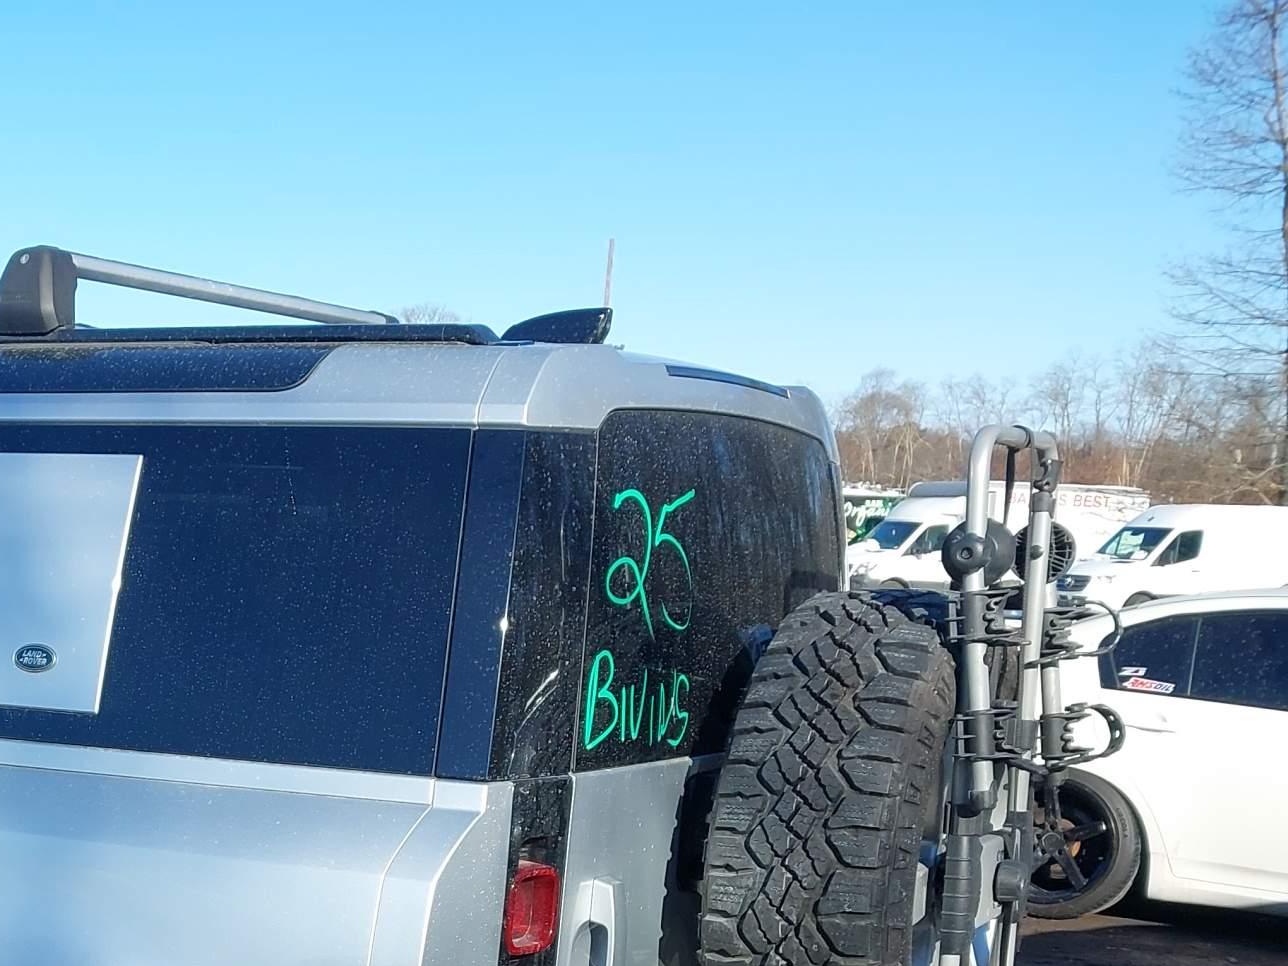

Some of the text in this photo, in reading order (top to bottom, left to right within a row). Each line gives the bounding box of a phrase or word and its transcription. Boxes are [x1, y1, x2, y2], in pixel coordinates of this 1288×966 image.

[1073, 493, 1112, 508] BEST
[605, 487, 696, 640] 25
[22, 649, 43, 658] LAND
[23, 657, 48, 666] ROVER
